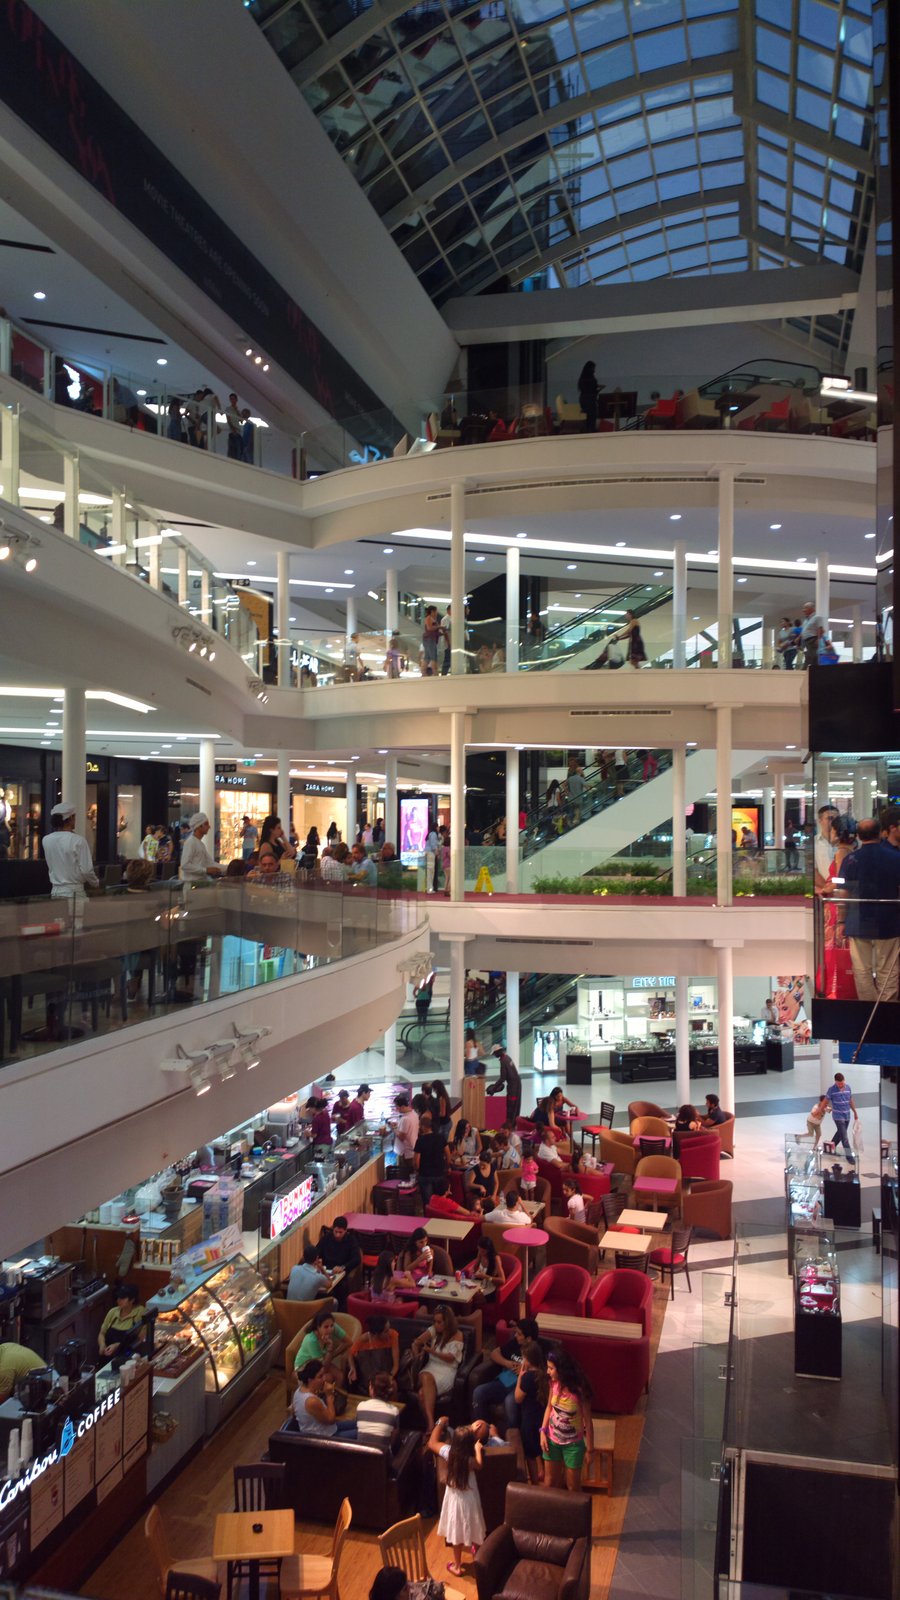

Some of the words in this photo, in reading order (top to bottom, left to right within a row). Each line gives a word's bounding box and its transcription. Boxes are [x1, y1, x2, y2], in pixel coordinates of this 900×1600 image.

[215, 774, 226, 784] RA
[227, 776, 247, 786] HOME
[305, 783, 320, 791] ZARA
[321, 785, 336, 793] HOME
[632, 976, 656, 988] CITY
[283, 1193, 311, 1228] DONUTS
[0, 1448, 58, 1511] Caribou
[77, 1386, 121, 1438] COFFEE
